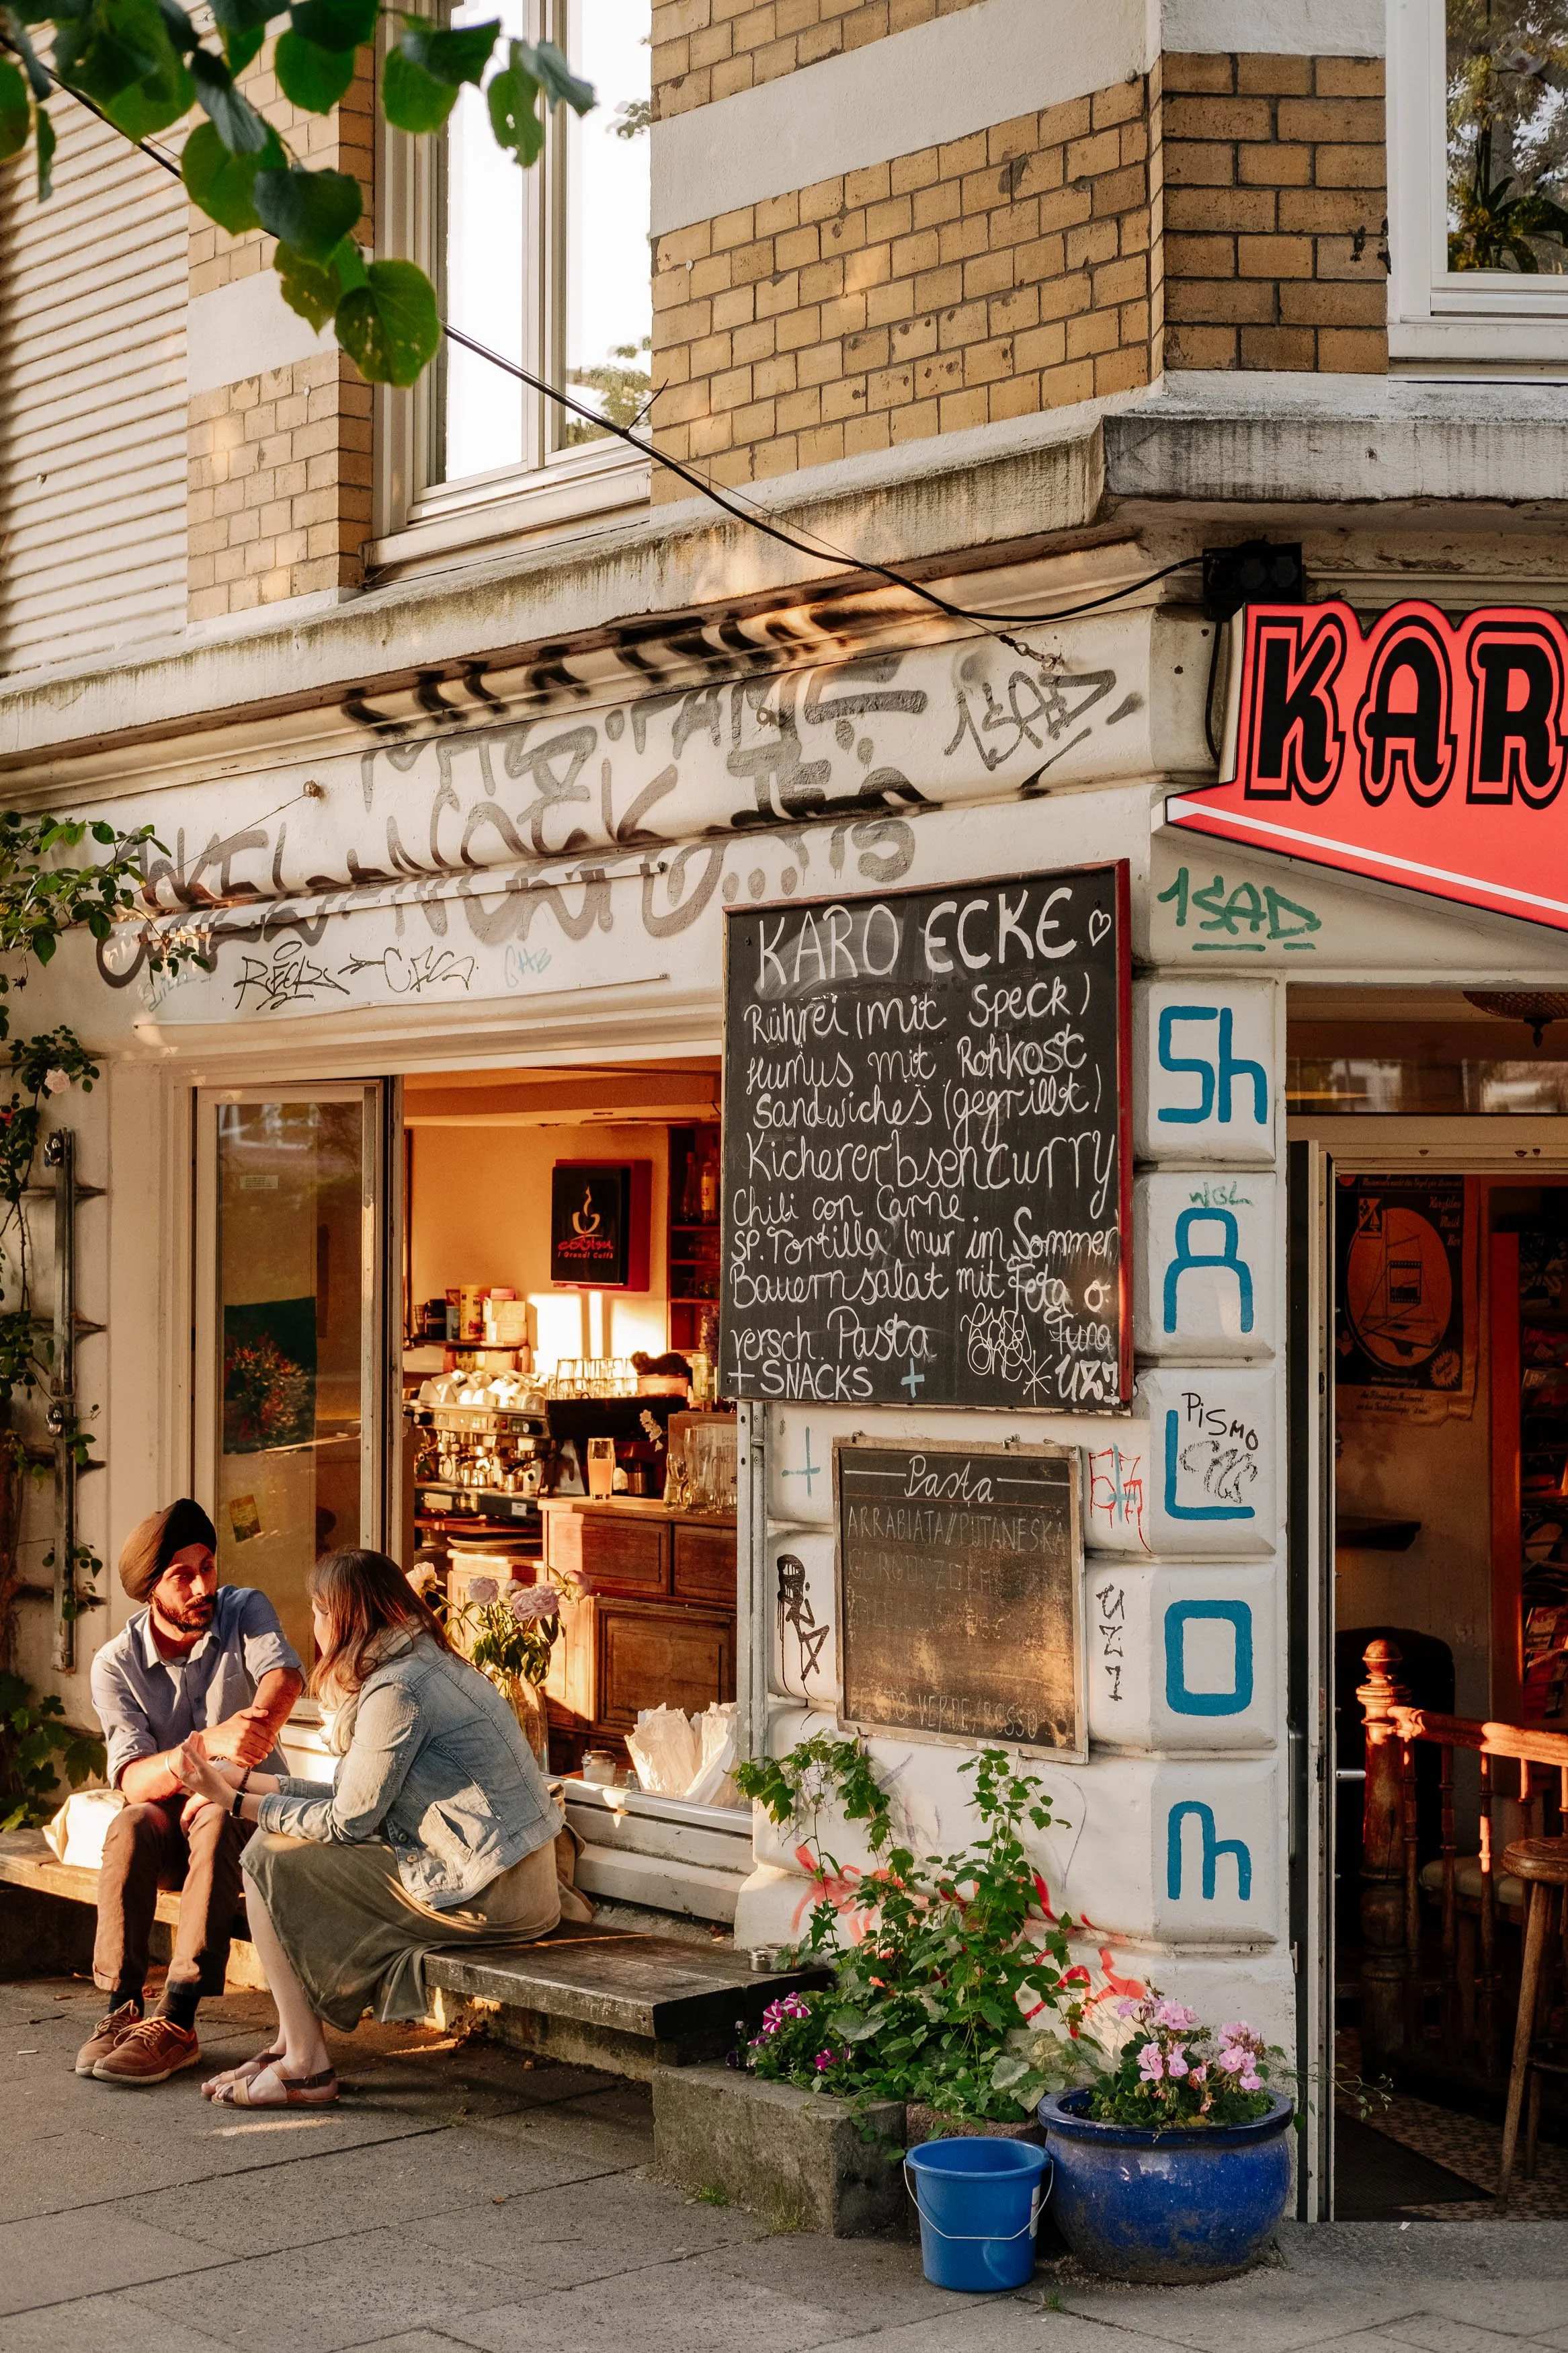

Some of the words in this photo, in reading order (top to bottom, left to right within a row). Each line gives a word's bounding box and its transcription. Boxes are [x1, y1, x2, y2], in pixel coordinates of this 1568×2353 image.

[1244, 612, 1568, 811] KAR
[758, 904, 900, 988] KARO
[924, 886, 1078, 974] ECKE
[743, 1002, 850, 1045] Rührei
[868, 1042, 937, 1082] mit
[956, 1023, 1087, 1080] Rohkost
[752, 1084, 933, 1129] Sandwiches
[943, 1064, 1102, 1153] (gegrillt)
[733, 1185, 800, 1228] Chili
[812, 1194, 864, 1222] con
[876, 1185, 965, 1223] Carne
[964, 1216, 1007, 1261] im
[957, 1265, 1005, 1302] mit
[1007, 1256, 1071, 1314] Feta
[730, 1315, 825, 1362] versch.
[827, 1306, 938, 1363] Pasta
[759, 1359, 874, 1402] SNACKS
[903, 1453, 994, 1503] Pasta
